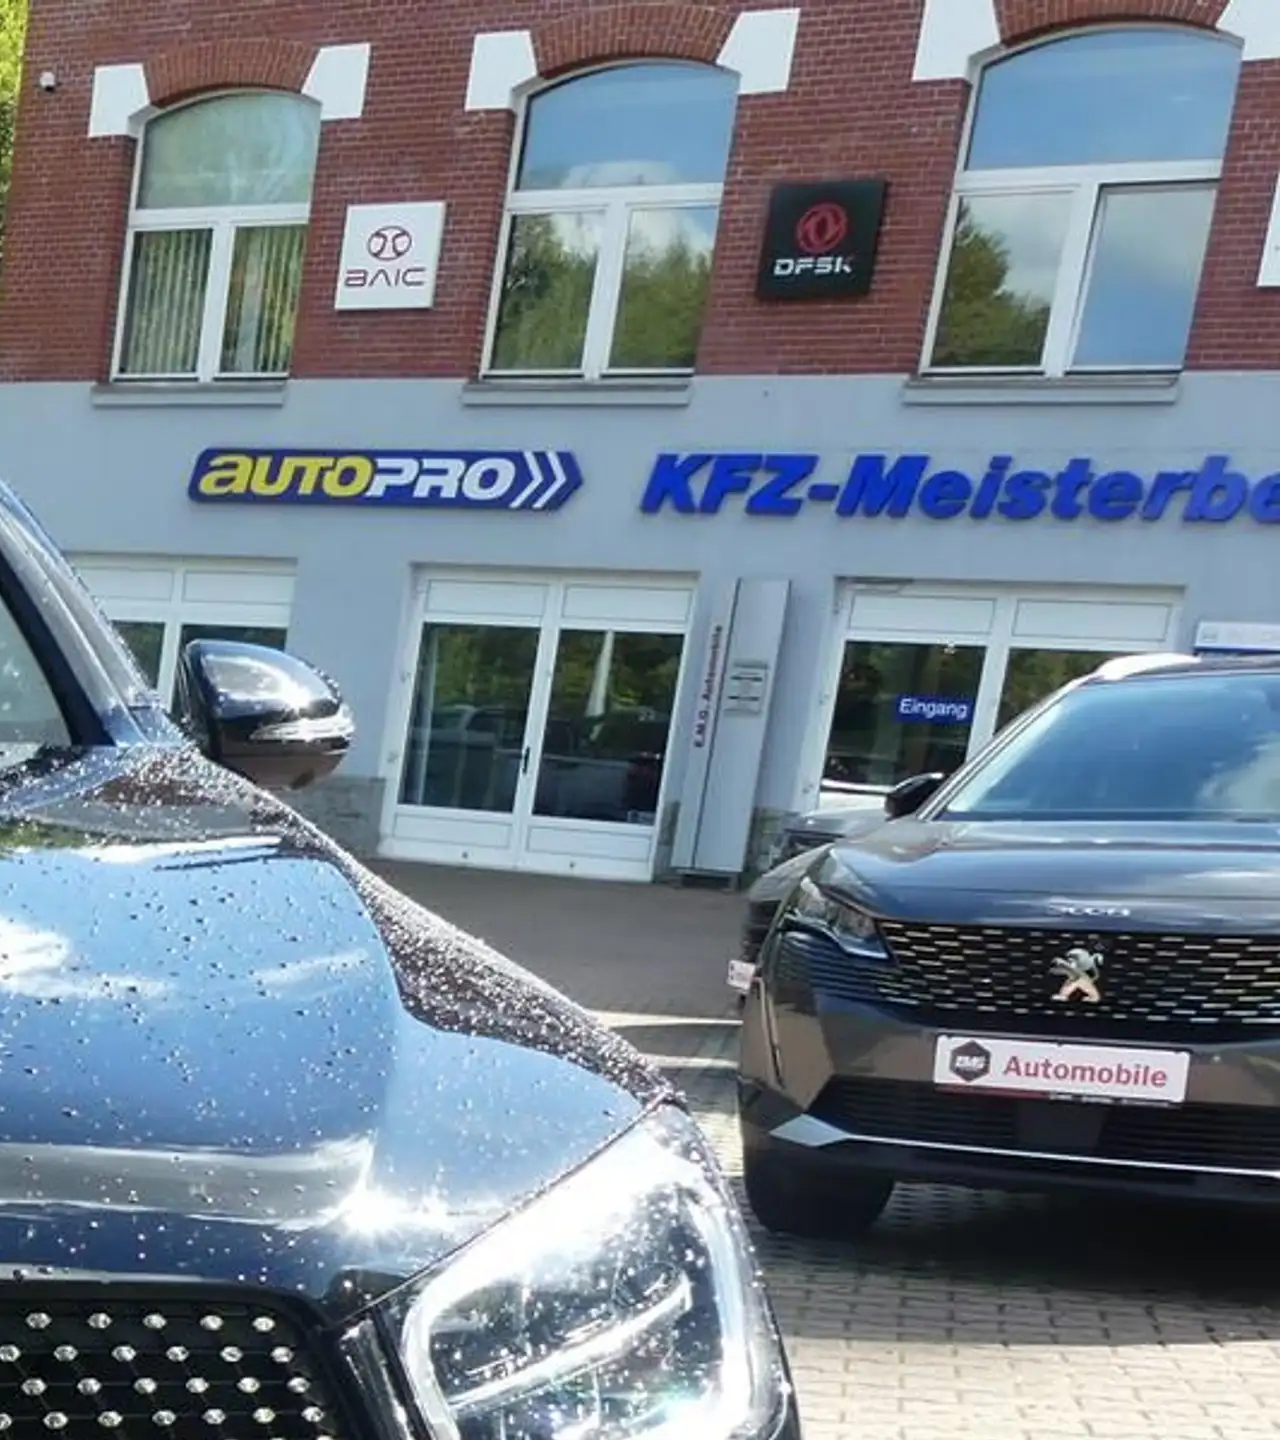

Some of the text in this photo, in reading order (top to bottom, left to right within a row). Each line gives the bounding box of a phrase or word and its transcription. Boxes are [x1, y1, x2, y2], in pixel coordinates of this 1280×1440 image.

[773, 256, 853, 276] DFSK
[344, 267, 426, 287] BAIC
[899, 698, 968, 720] Eingang
[1003, 1055, 1168, 1087] Automobile
